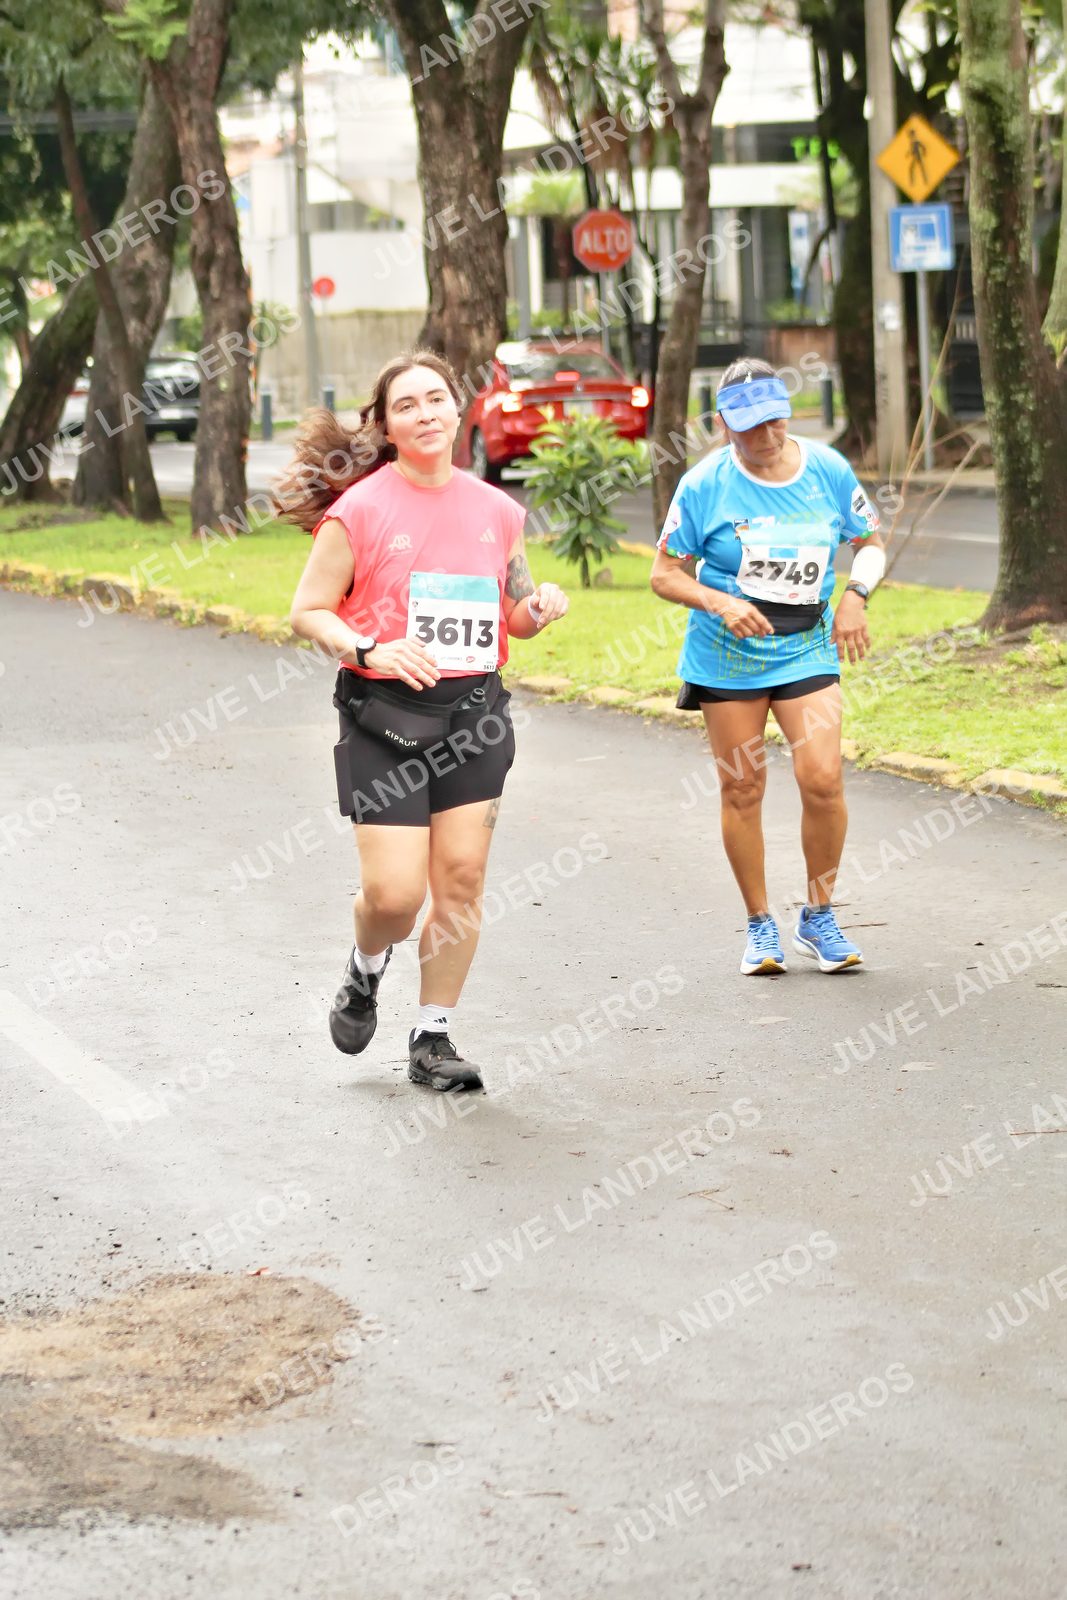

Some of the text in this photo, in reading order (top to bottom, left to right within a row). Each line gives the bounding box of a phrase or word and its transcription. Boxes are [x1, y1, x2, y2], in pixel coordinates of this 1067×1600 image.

[578, 228, 628, 254] ALTO
[744, 560, 820, 586] 2749
[415, 615, 494, 648] 3613
[384, 729, 418, 747] KIPRUN
